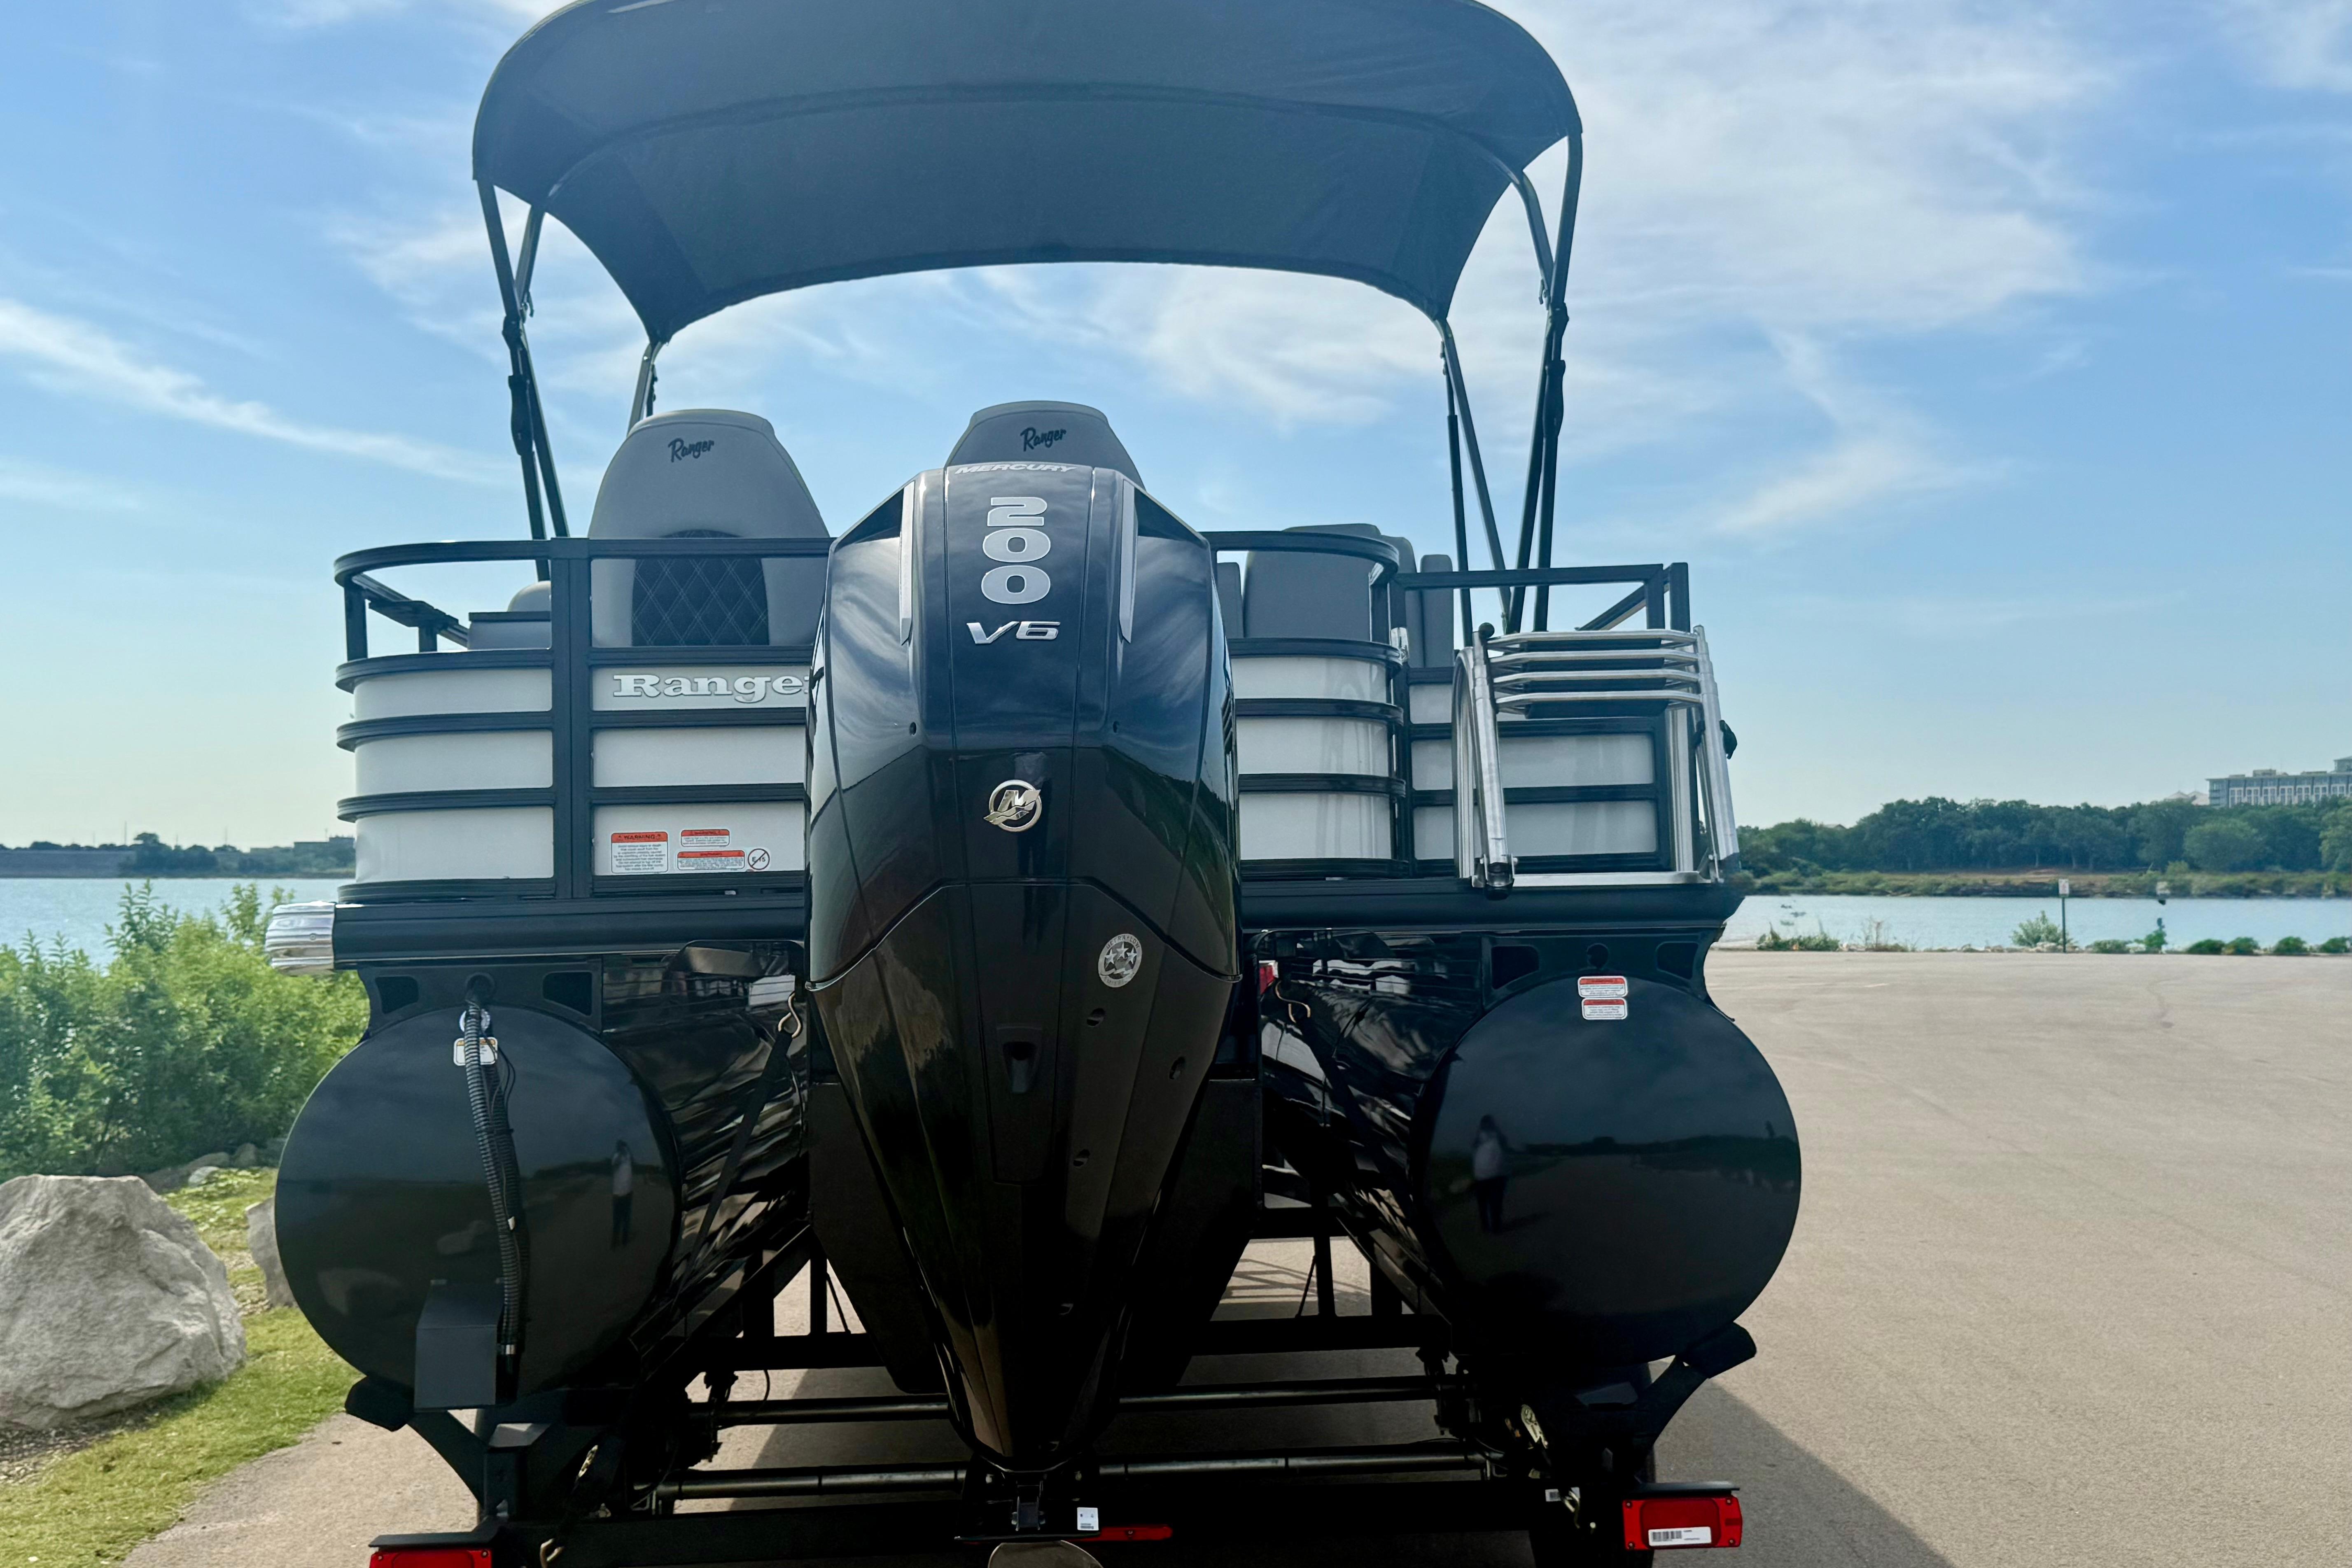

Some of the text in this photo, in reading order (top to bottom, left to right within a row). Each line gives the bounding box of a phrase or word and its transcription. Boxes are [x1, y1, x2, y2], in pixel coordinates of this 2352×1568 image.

[668, 438, 714, 463] Ranger
[1020, 427, 1066, 452] Ranger
[954, 464, 1077, 474] MERCURY
[981, 496, 1051, 604] 200
[966, 621, 1061, 644] V6
[613, 674, 810, 703] Range
